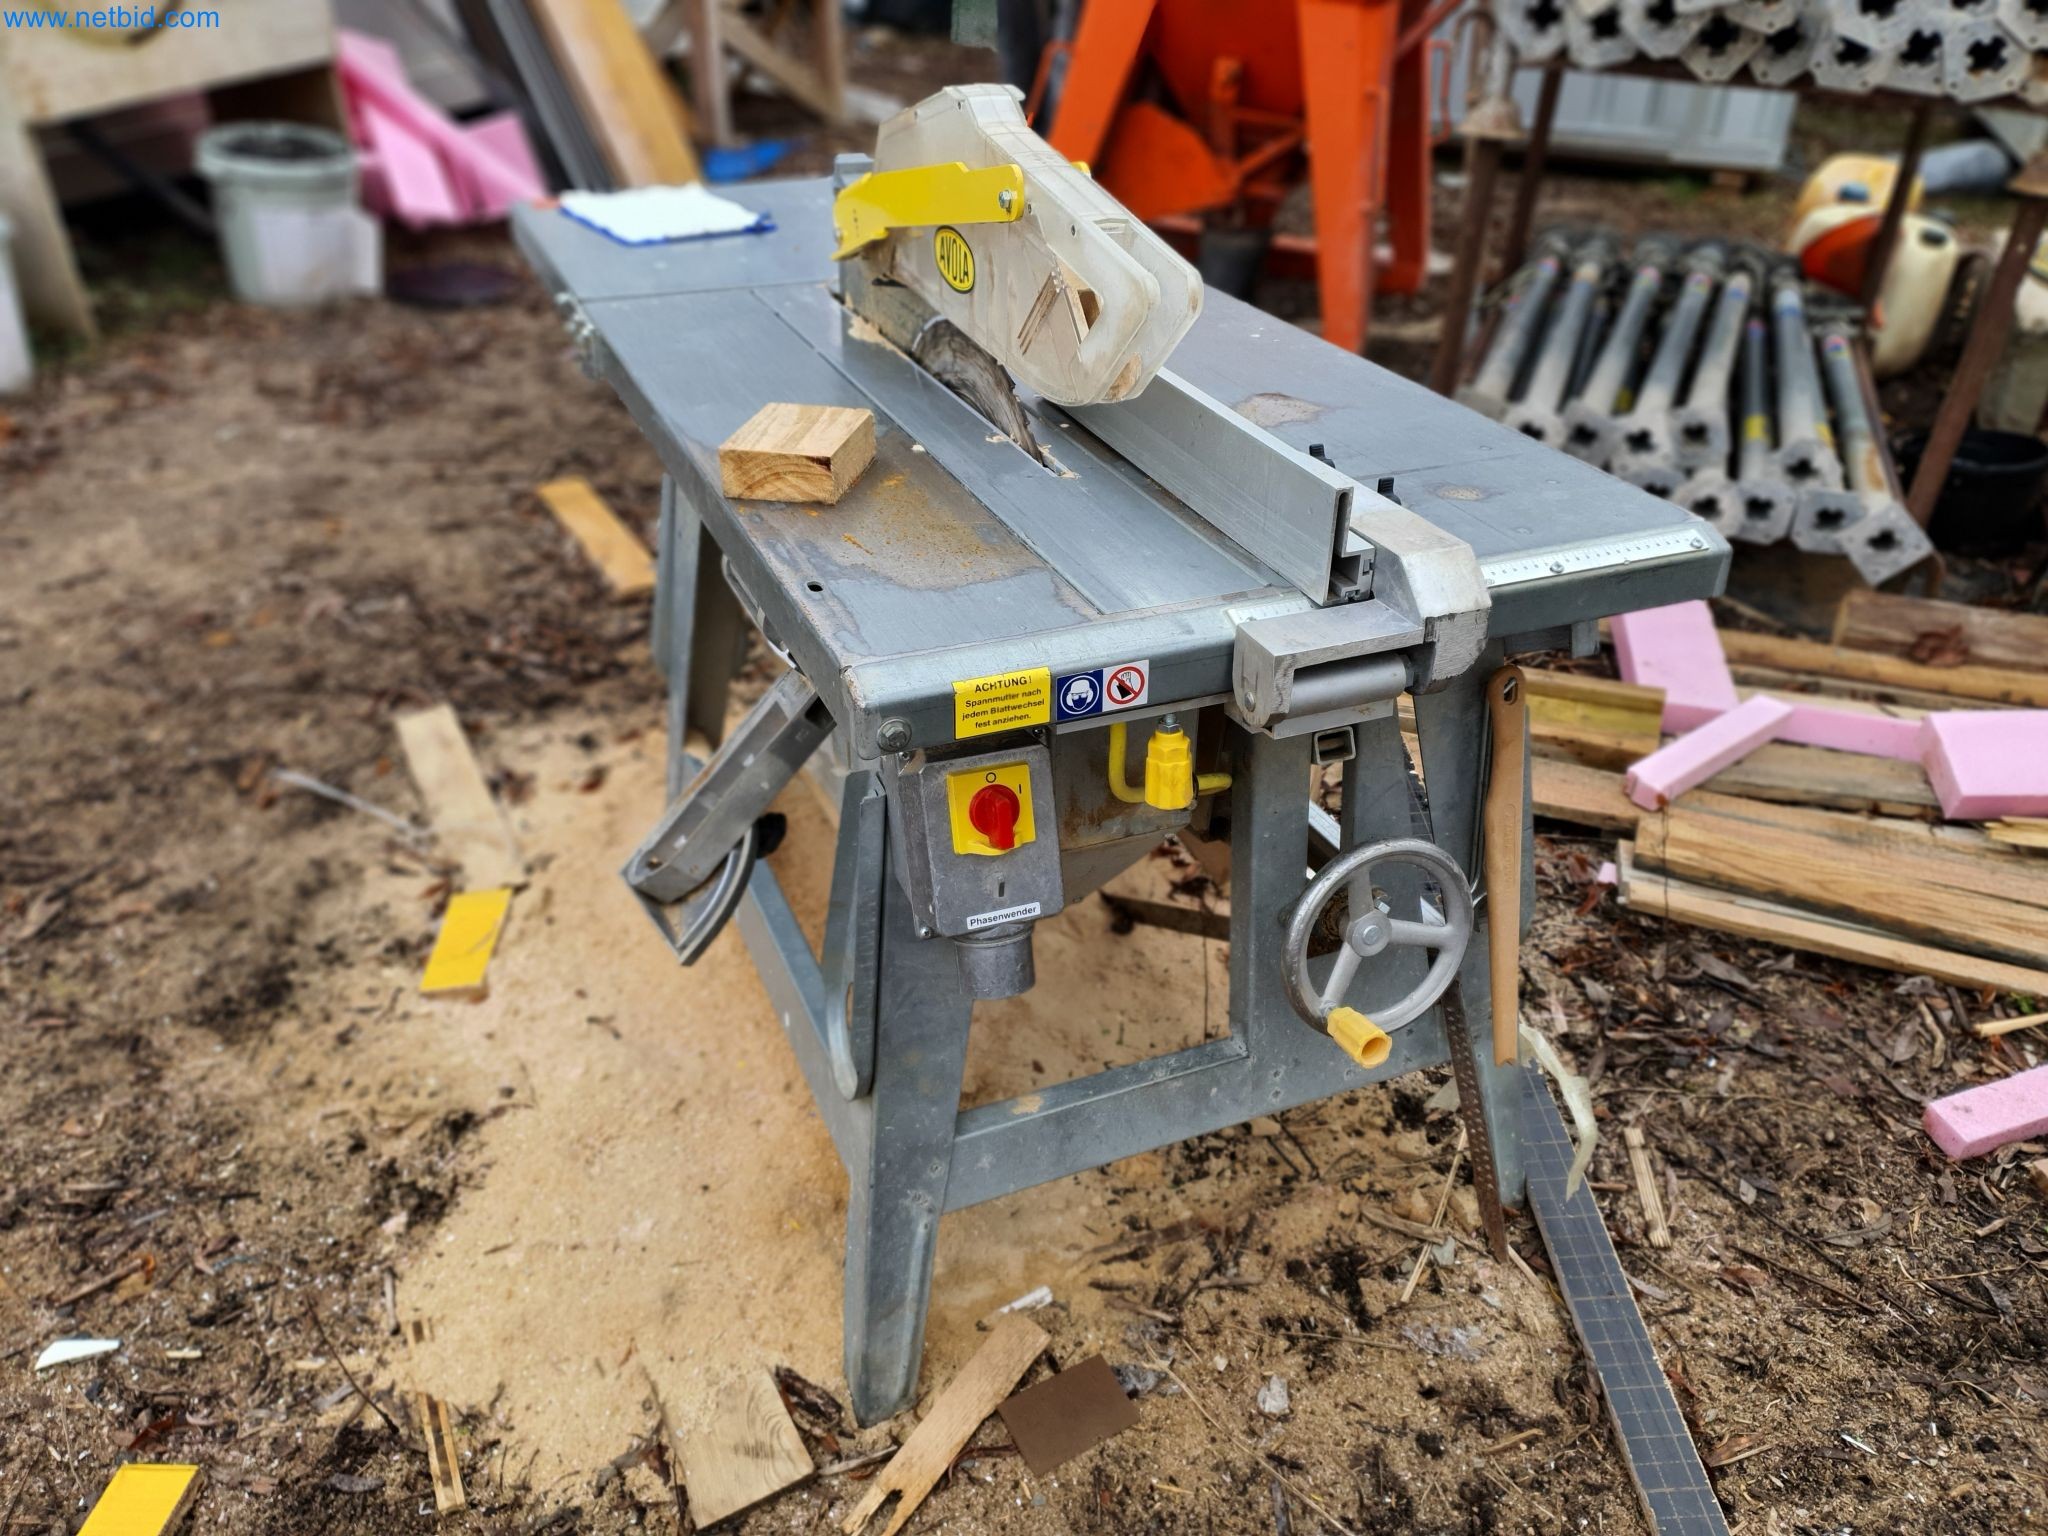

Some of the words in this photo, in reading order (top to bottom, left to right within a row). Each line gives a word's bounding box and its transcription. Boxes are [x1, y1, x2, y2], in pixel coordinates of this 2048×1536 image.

[939, 234, 970, 283] AVOLA
[962, 708, 989, 720] jedem
[990, 698, 1045, 714] Blattwechsel
[965, 691, 1019, 708] Spannmutter
[1021, 688, 1042, 698] nach
[975, 719, 991, 729] fest
[992, 713, 1032, 726] anziehen.
[969, 905, 1037, 927] Phasenwender
